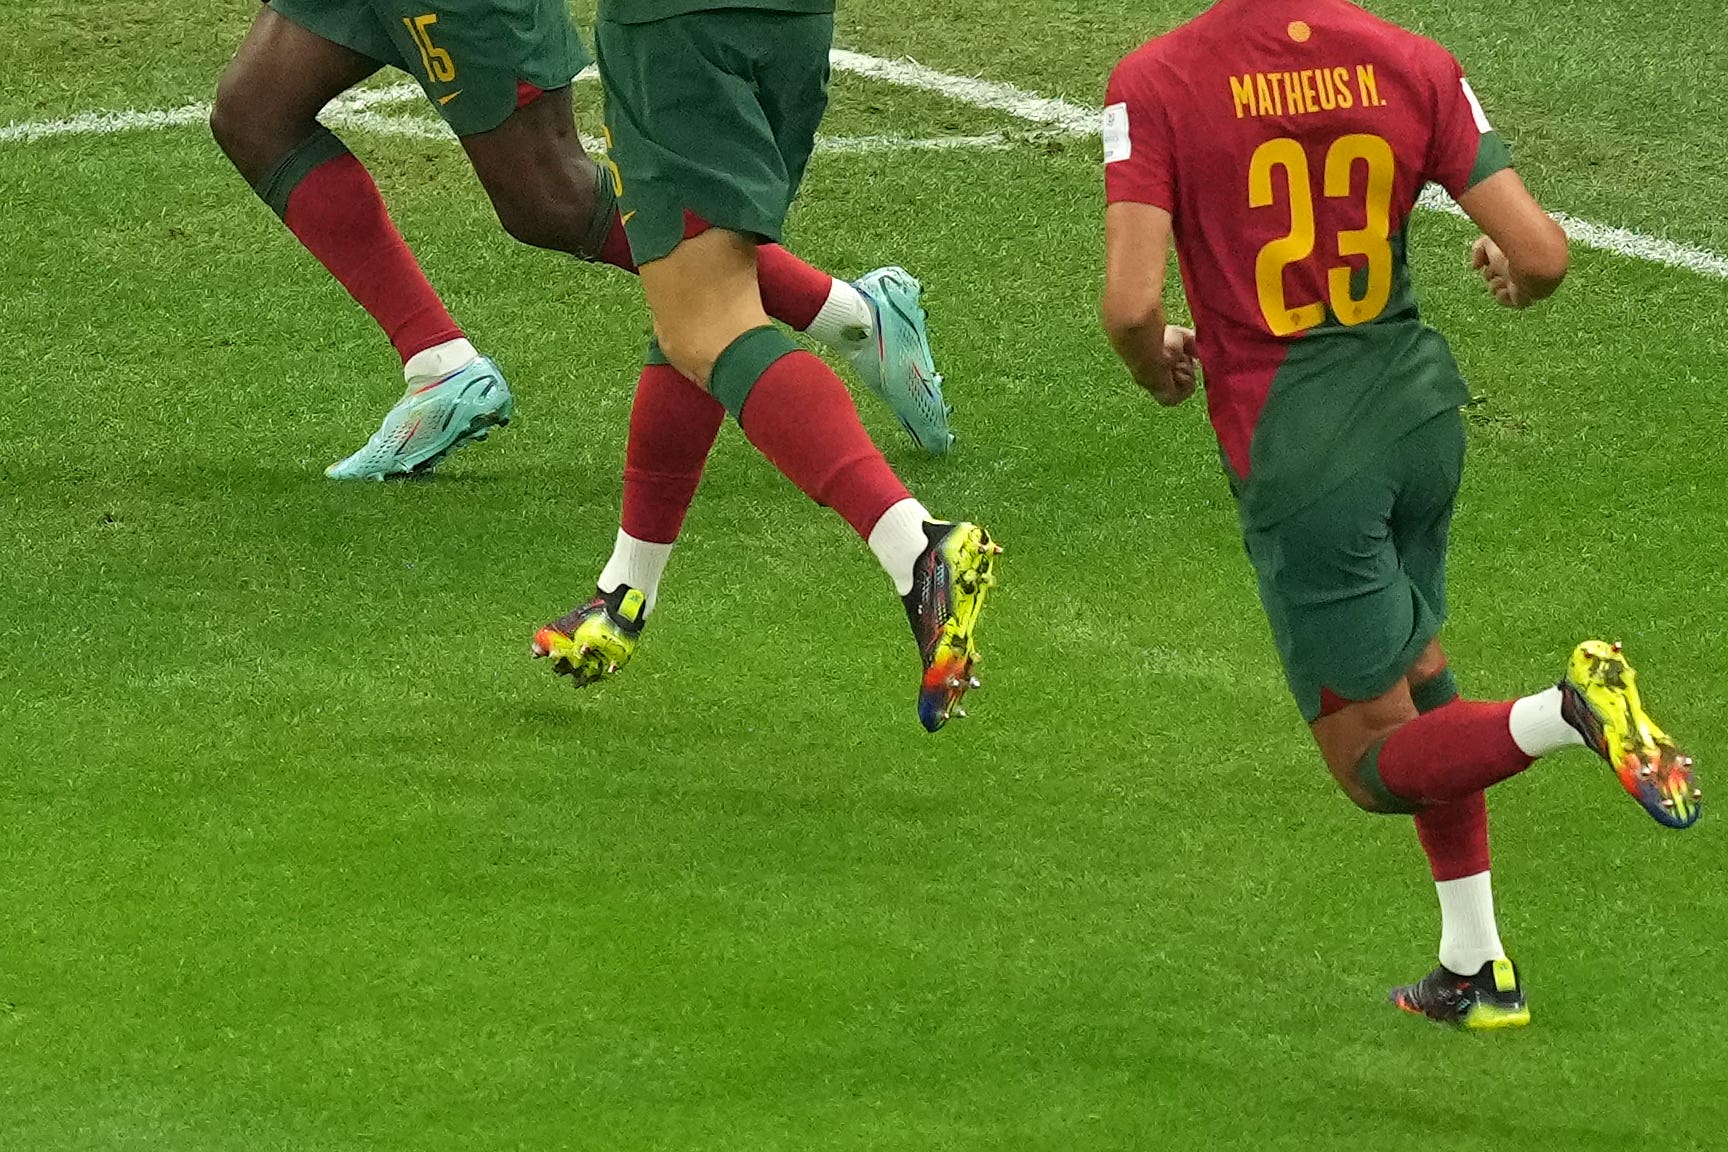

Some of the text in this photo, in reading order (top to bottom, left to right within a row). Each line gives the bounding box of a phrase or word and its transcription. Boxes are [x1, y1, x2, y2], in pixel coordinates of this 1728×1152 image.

[402, 13, 456, 83] 15
[1229, 64, 1387, 119] MATHEUS N.
[1248, 133, 1395, 337] 23
